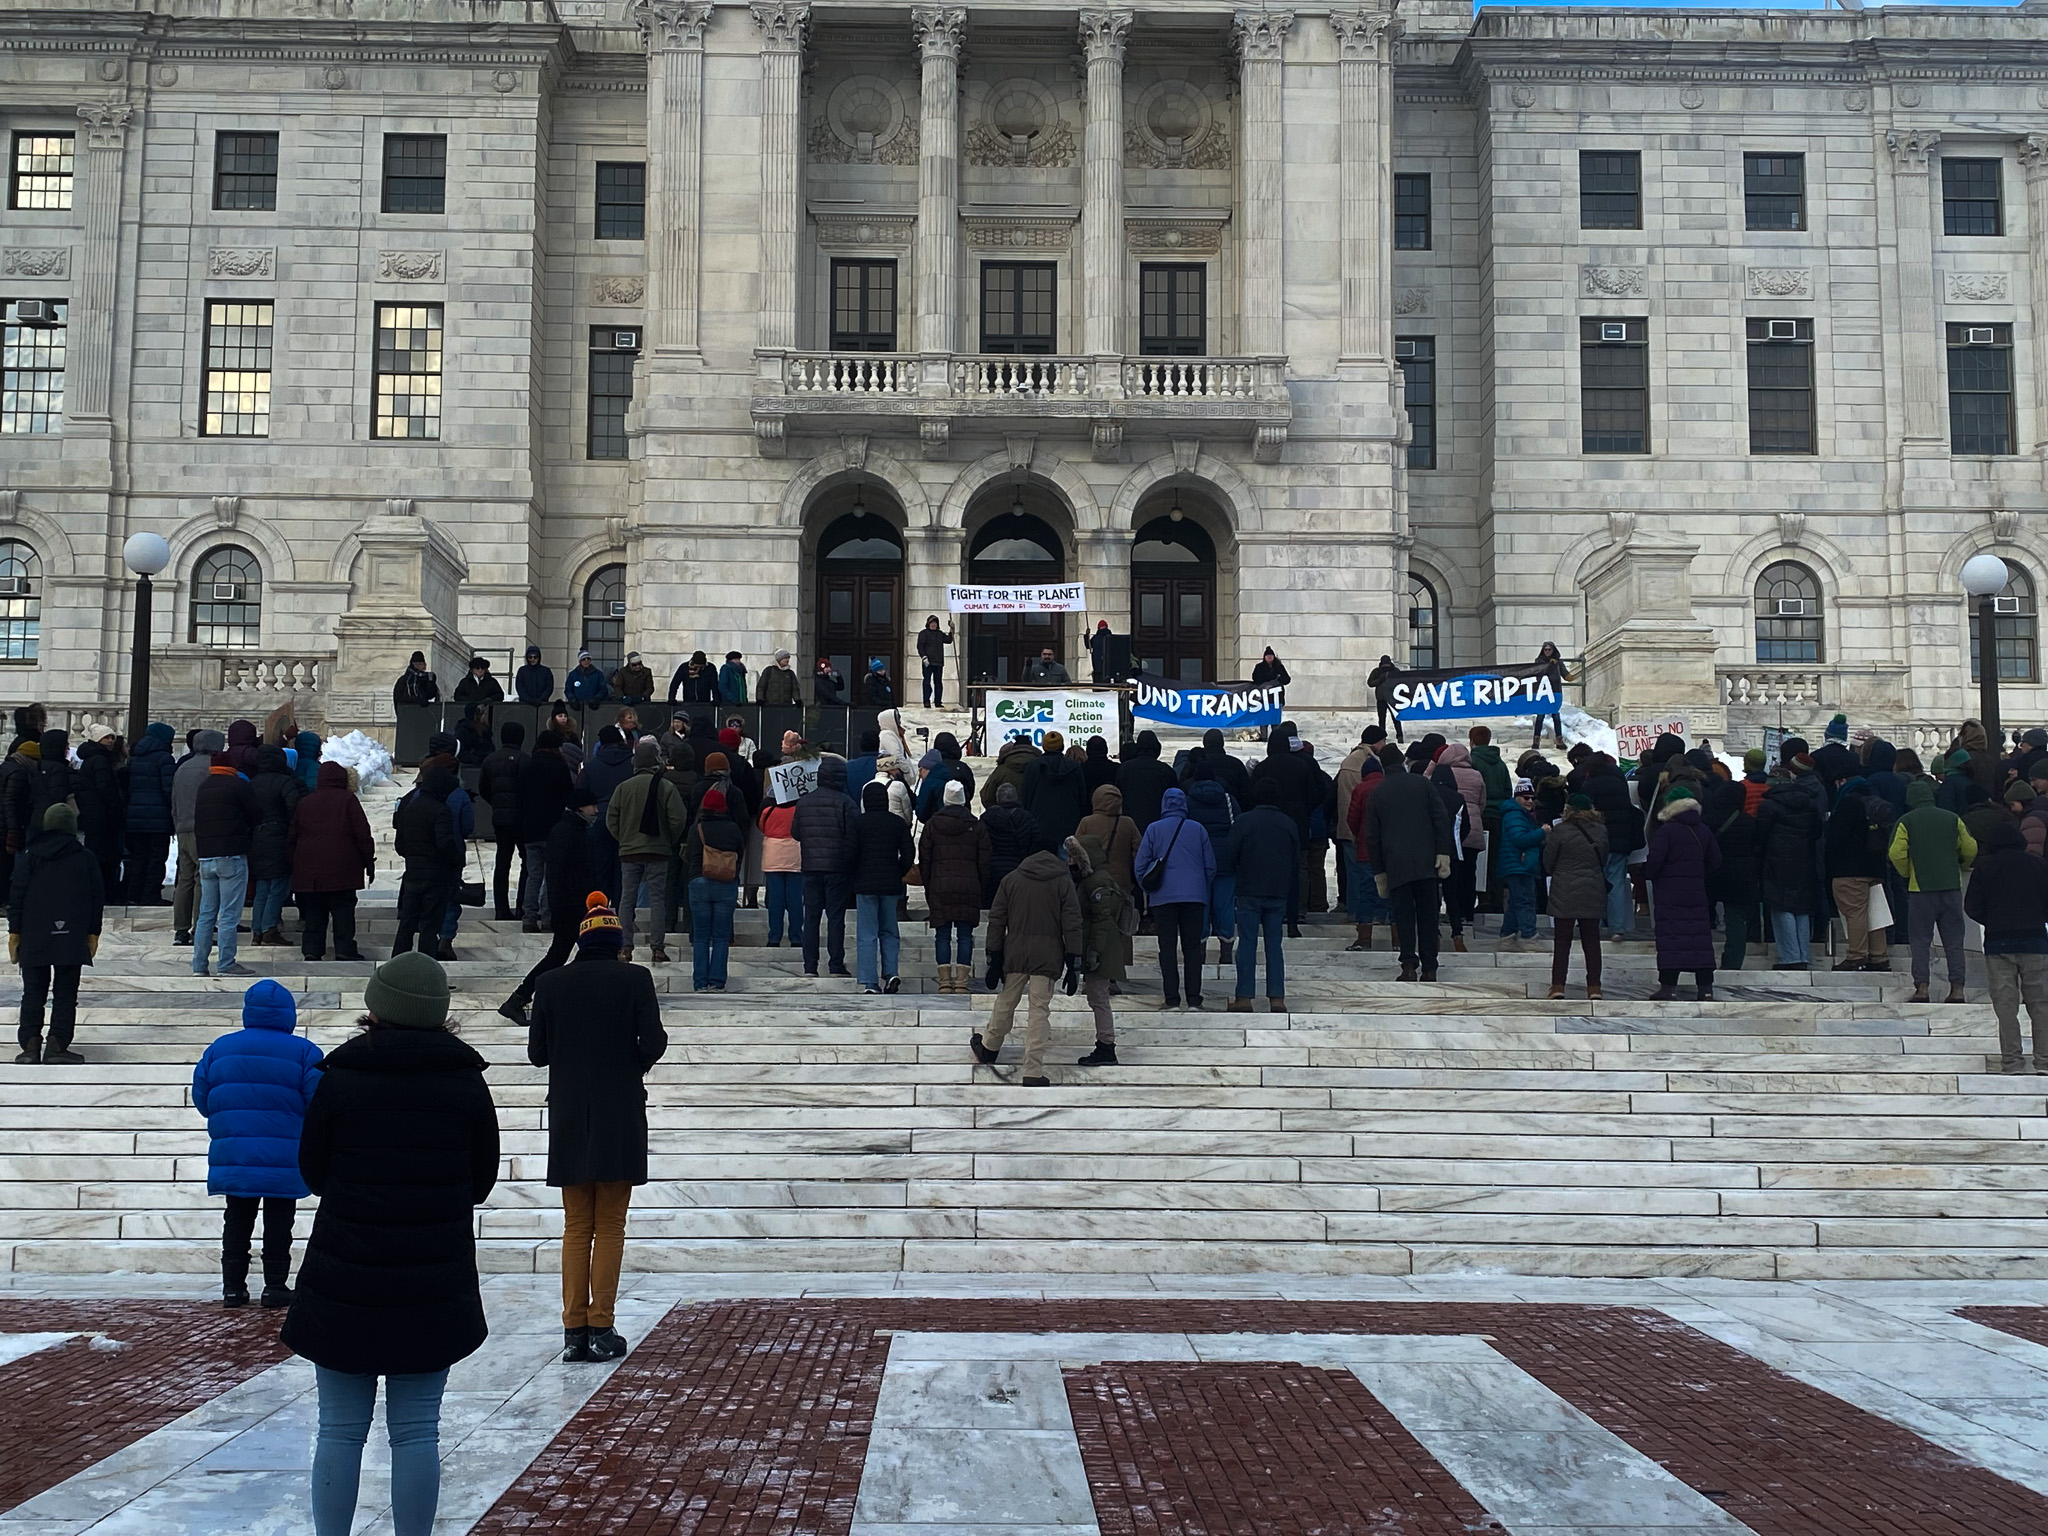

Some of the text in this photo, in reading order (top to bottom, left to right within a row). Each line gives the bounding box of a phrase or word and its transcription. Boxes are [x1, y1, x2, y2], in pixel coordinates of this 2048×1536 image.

[951, 587, 1081, 601] FIGHT FOR THE PLANET
[1392, 675, 1556, 711] SAVE RIPTA
[1065, 699, 1106, 708] Climate
[1187, 686, 1283, 718] TRANSIT
[1068, 712, 1103, 721] Action
[1069, 725, 1103, 734] Rhode
[1616, 721, 1684, 738] THERE IS NO
[1618, 736, 1659, 757] PLANE
[775, 765, 804, 783] NO
[782, 771, 819, 792] PLANE
[796, 784, 809, 796] B
